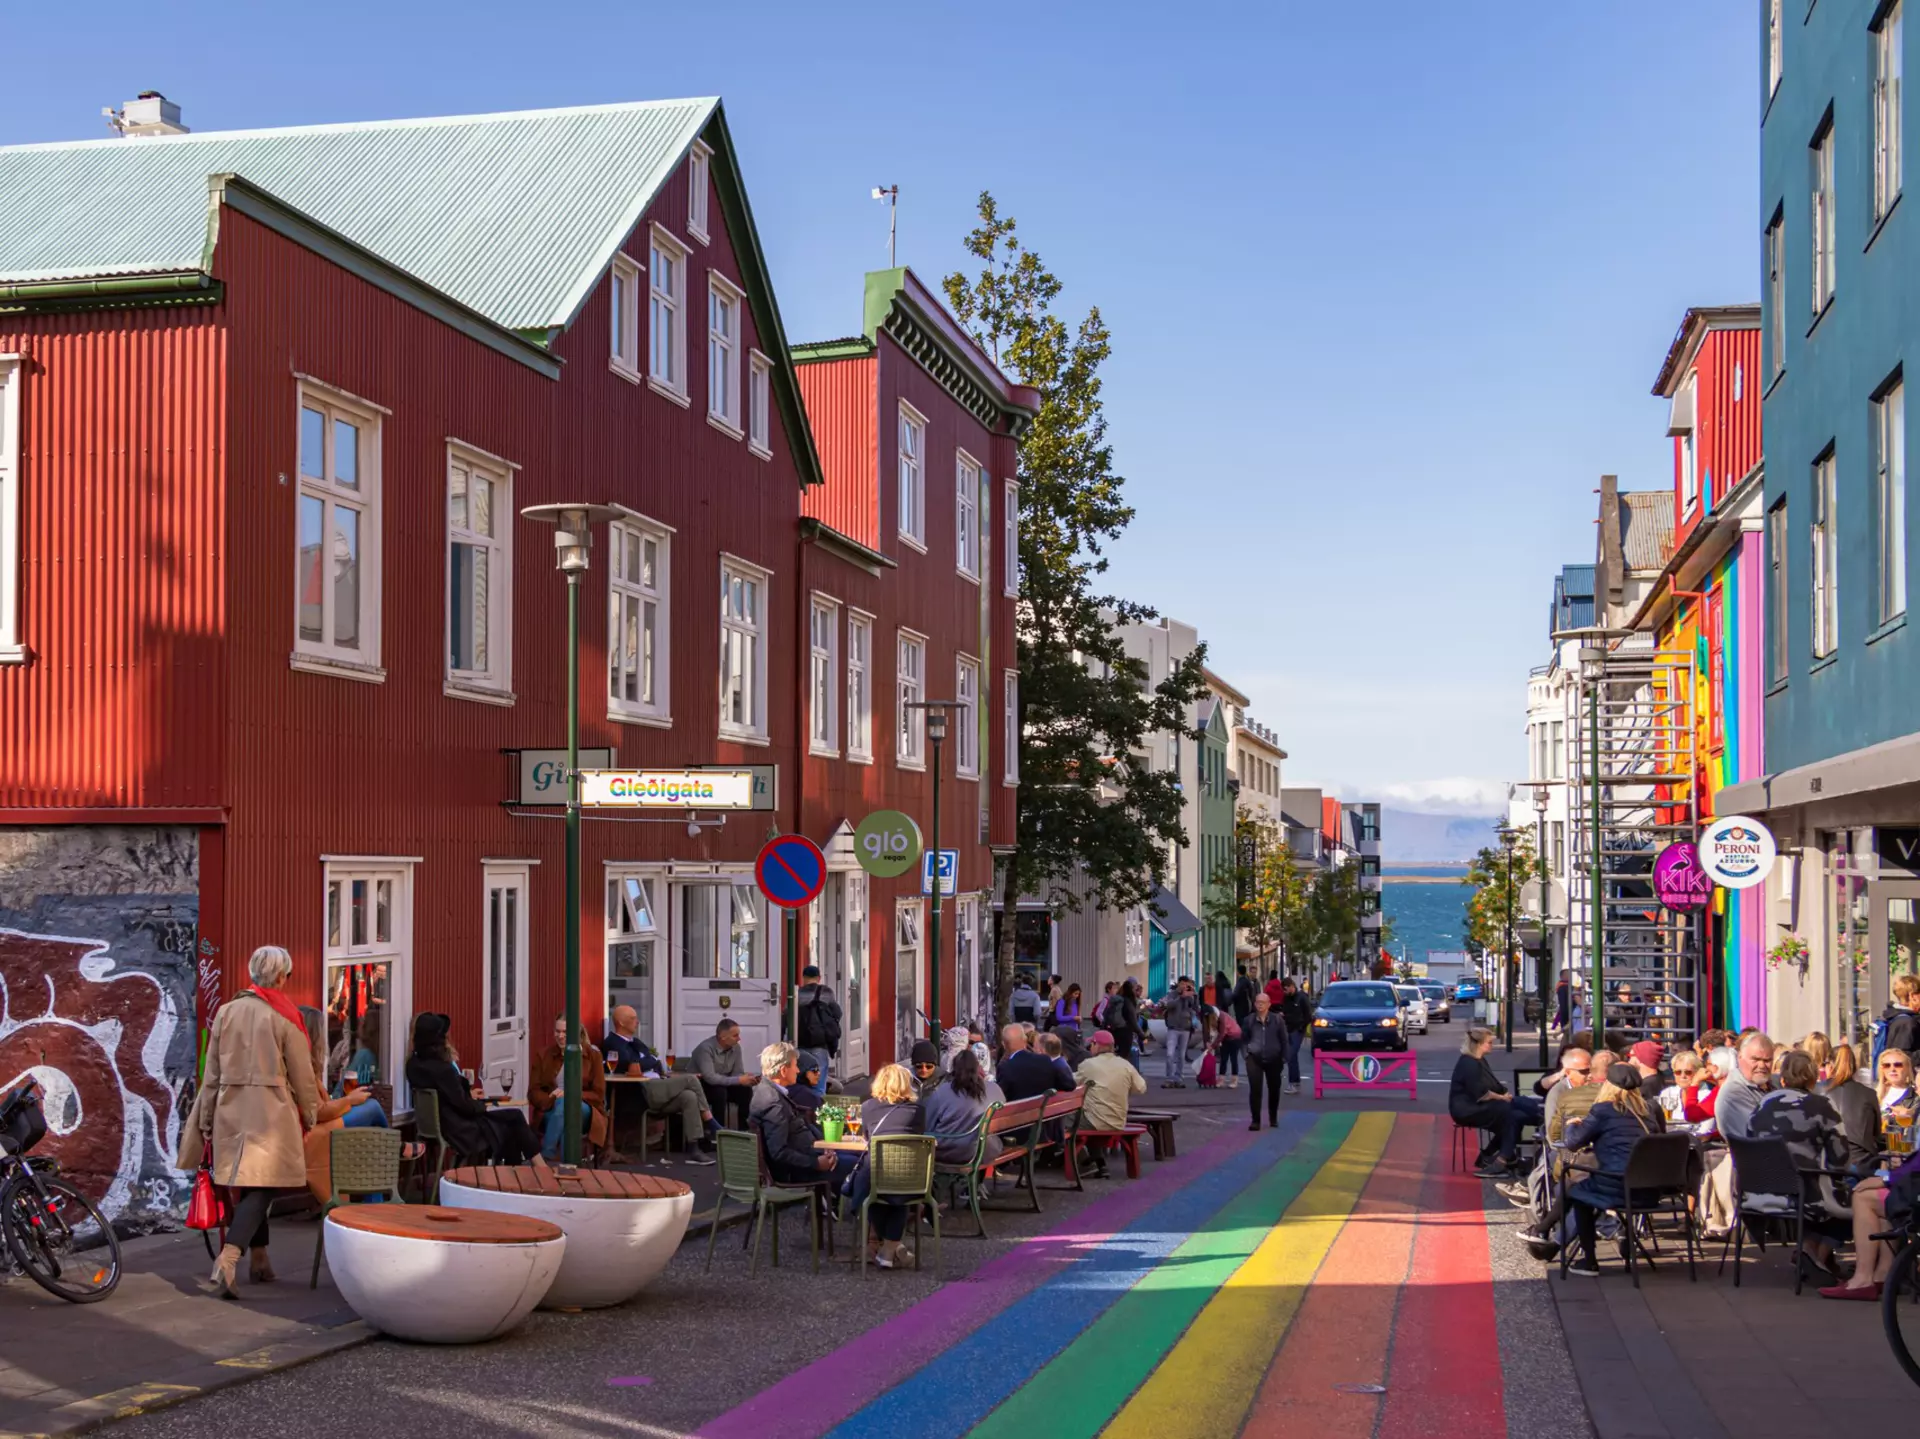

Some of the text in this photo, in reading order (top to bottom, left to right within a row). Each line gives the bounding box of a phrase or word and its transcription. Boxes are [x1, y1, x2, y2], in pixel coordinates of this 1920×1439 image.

[609, 777, 714, 802] Gleðigata
[863, 828, 908, 859] gló
[1714, 843, 1761, 854] PERONI
[1661, 869, 1712, 892] KIKI
